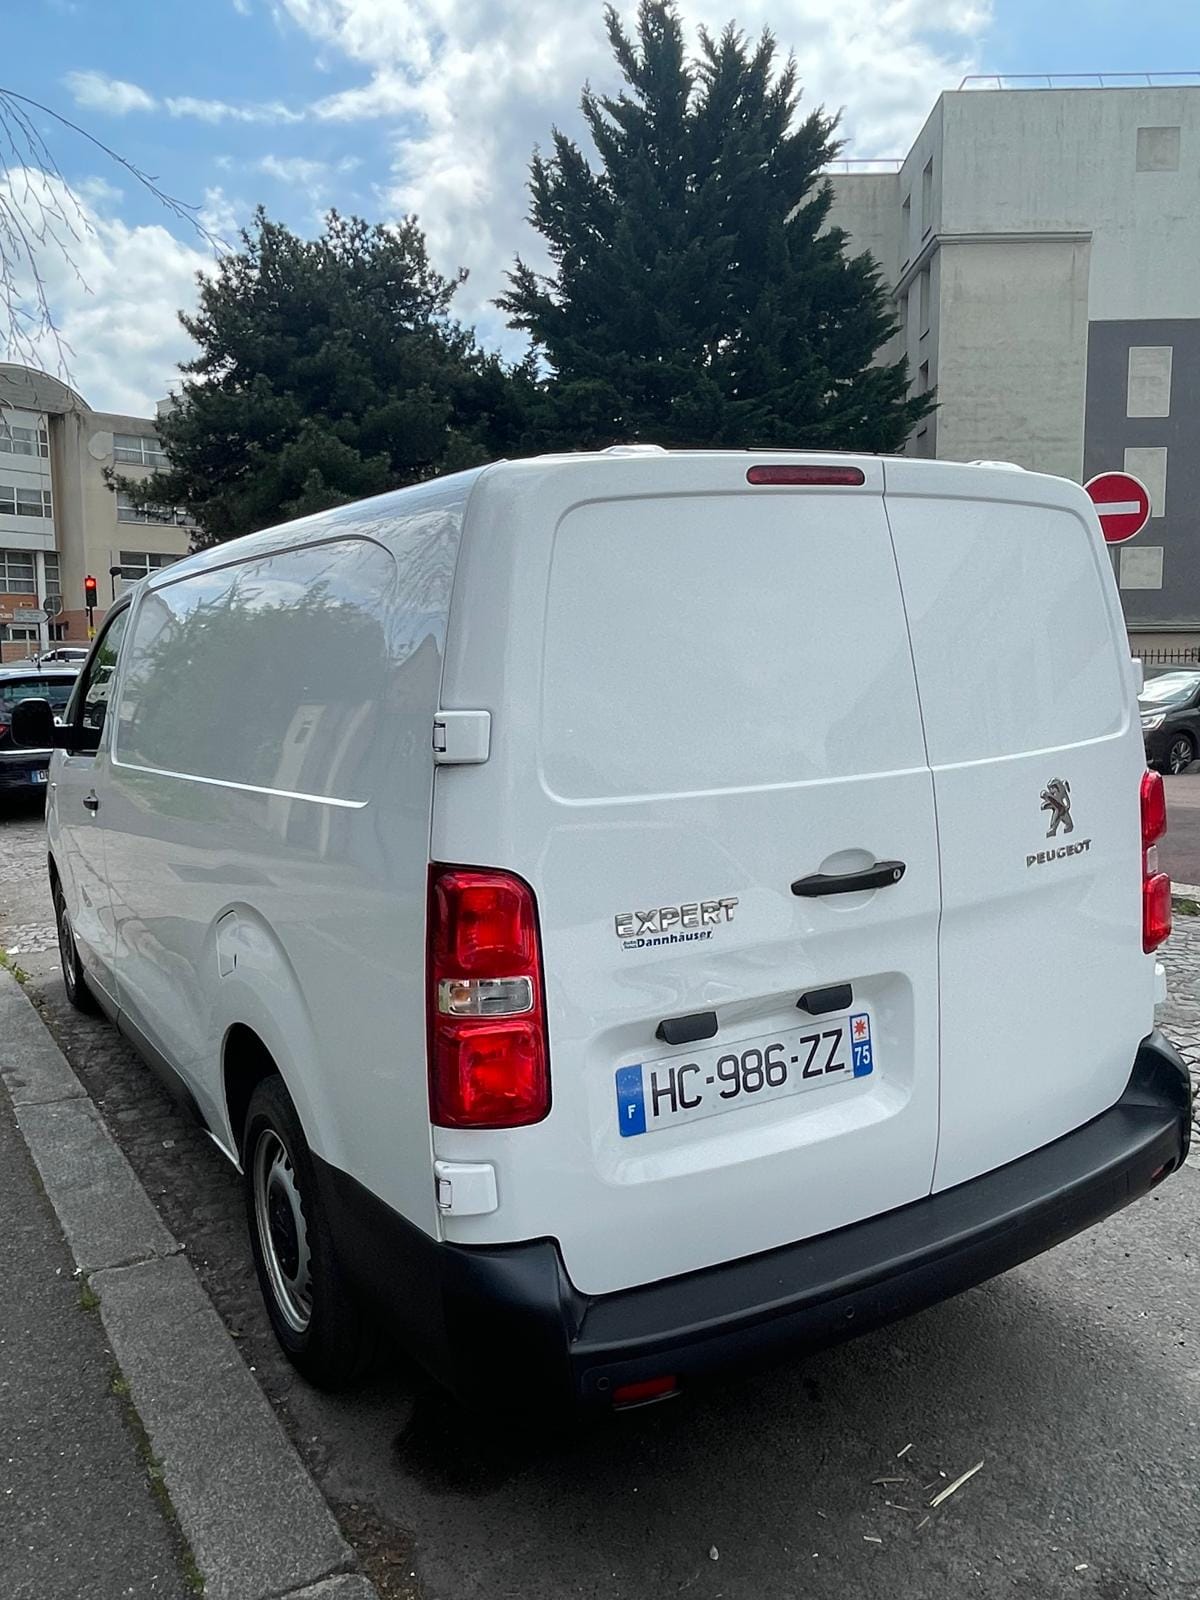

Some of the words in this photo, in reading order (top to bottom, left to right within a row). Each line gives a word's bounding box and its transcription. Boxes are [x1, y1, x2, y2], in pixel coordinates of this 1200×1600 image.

[1026, 839, 1092, 867] PEUGEOT
[614, 897, 739, 938] EXPERT
[637, 930, 712, 948] Dannhäuser
[854, 1045, 871, 1067] 75
[627, 1104, 636, 1119] F
[650, 1028, 845, 1117] HC-986-ZZ
